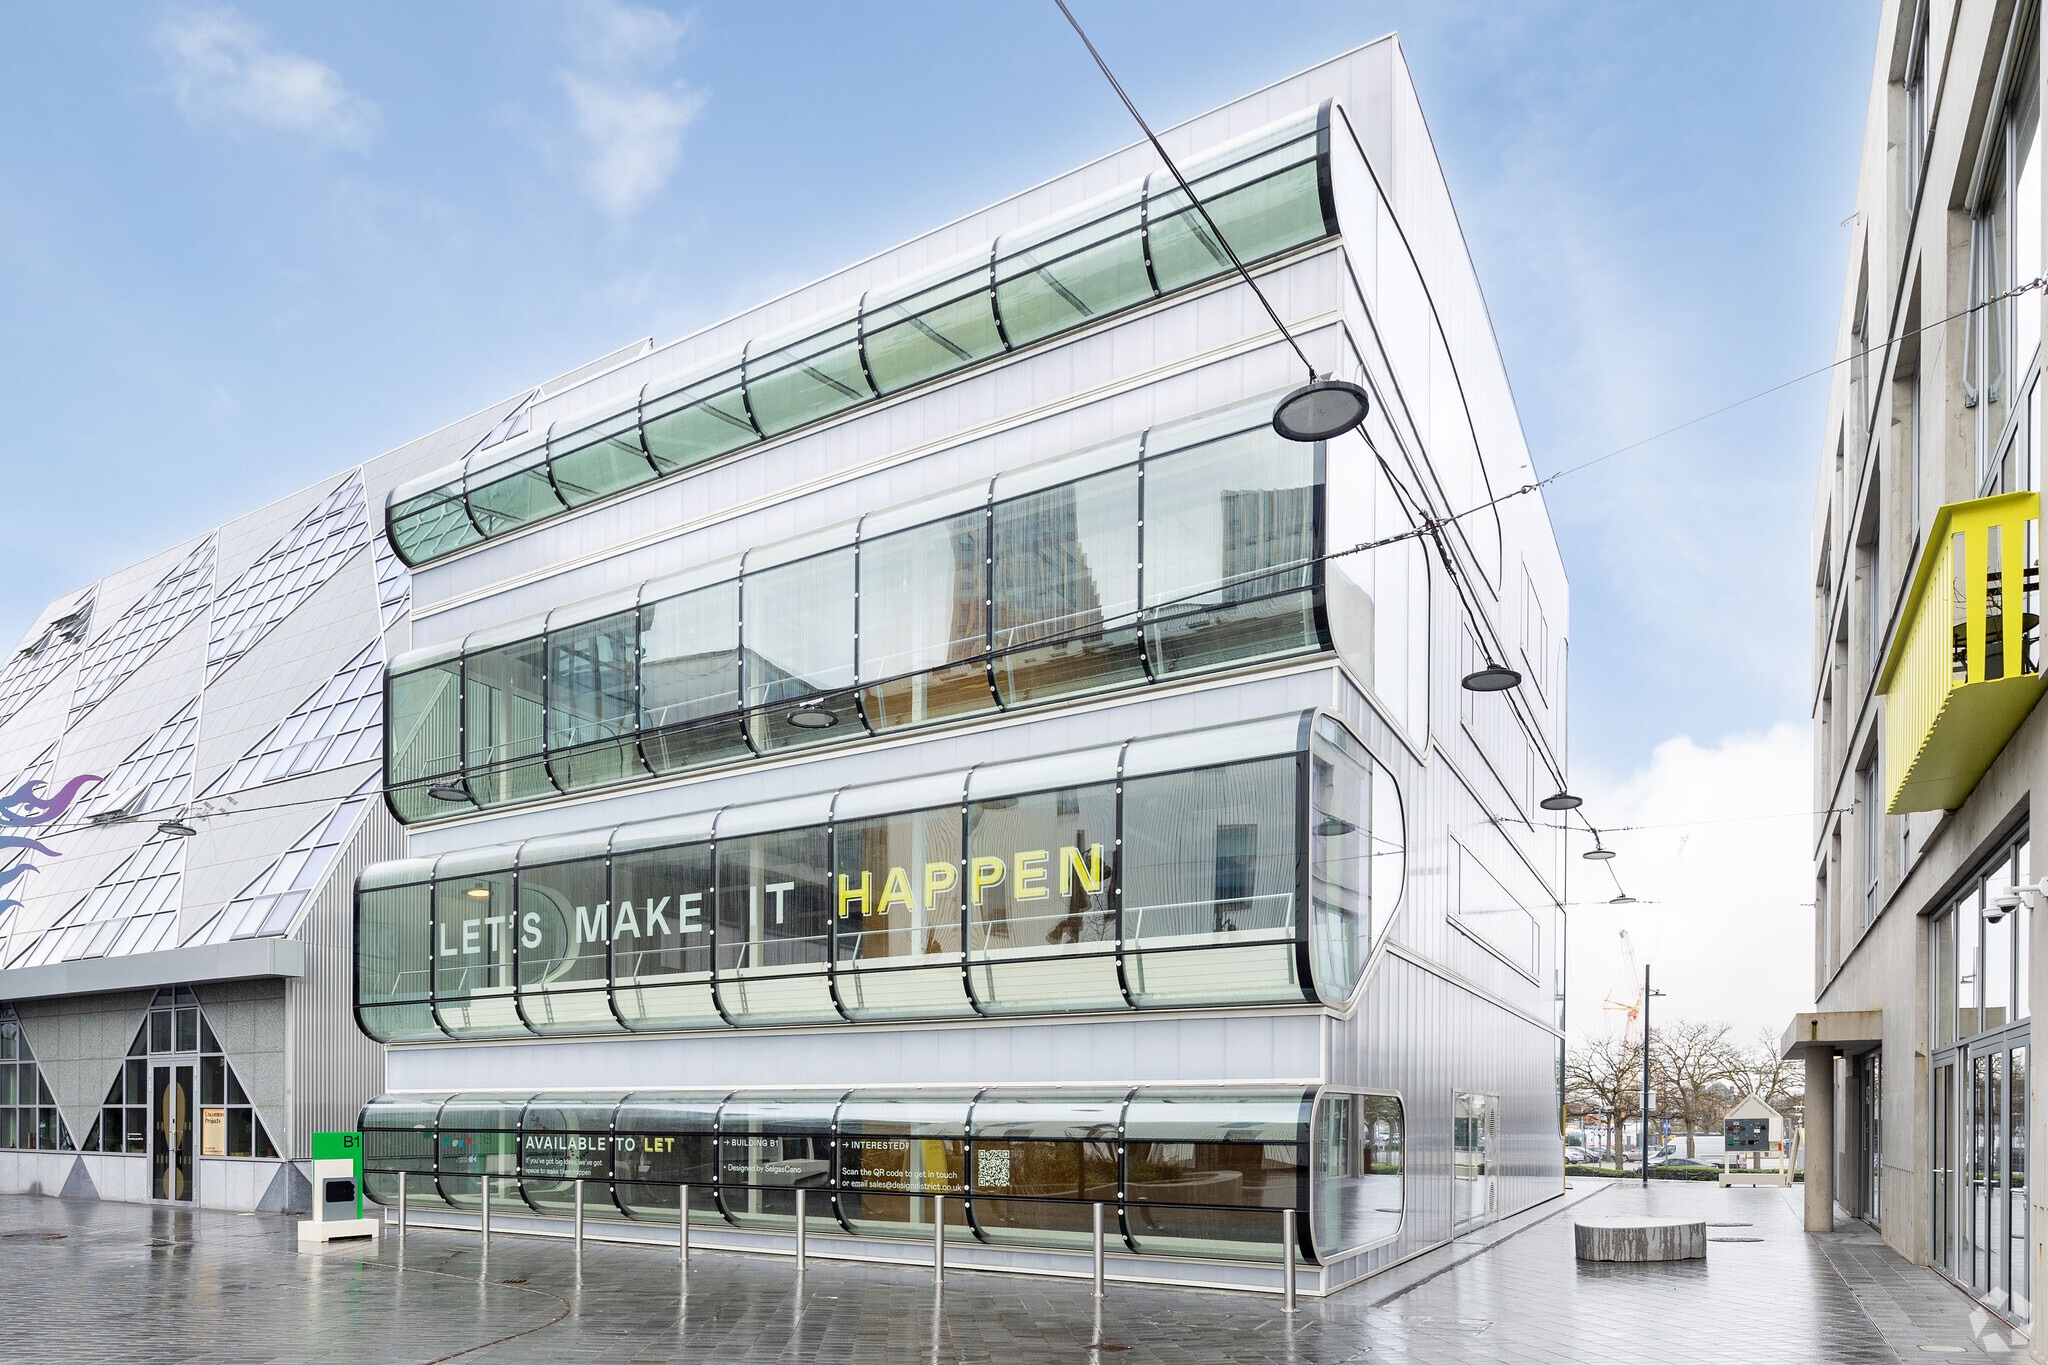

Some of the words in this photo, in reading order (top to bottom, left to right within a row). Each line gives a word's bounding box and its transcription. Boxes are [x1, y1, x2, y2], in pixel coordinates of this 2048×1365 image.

[440, 911, 542, 957] LET'S
[575, 892, 703, 944] MAKE
[749, 881, 794, 925] IT
[838, 842, 1104, 919] HAPPEN
[343, 1135, 360, 1148] B1
[525, 1135, 606, 1150] AVAILABLE
[615, 1137, 636, 1152] TO
[644, 1137, 675, 1153] LET
[731, 1138, 768, 1147] BUILDING
[851, 1141, 910, 1150] INTERESTED?
[546, 1158, 554, 1166] got
[593, 1159, 603, 1168] got
[727, 1163, 755, 1174] Designed
[756, 1164, 763, 1174] by
[841, 1167, 859, 1176] Scan
[860, 1168, 872, 1176] the
[873, 1168, 885, 1177] QR
[885, 1169, 904, 1177] code
[904, 1170, 912, 1178] to
[913, 1170, 927, 1179] get
[927, 1170, 935, 1178] in
[936, 1170, 958, 1179] touch
[850, 1179, 868, 1187] email
